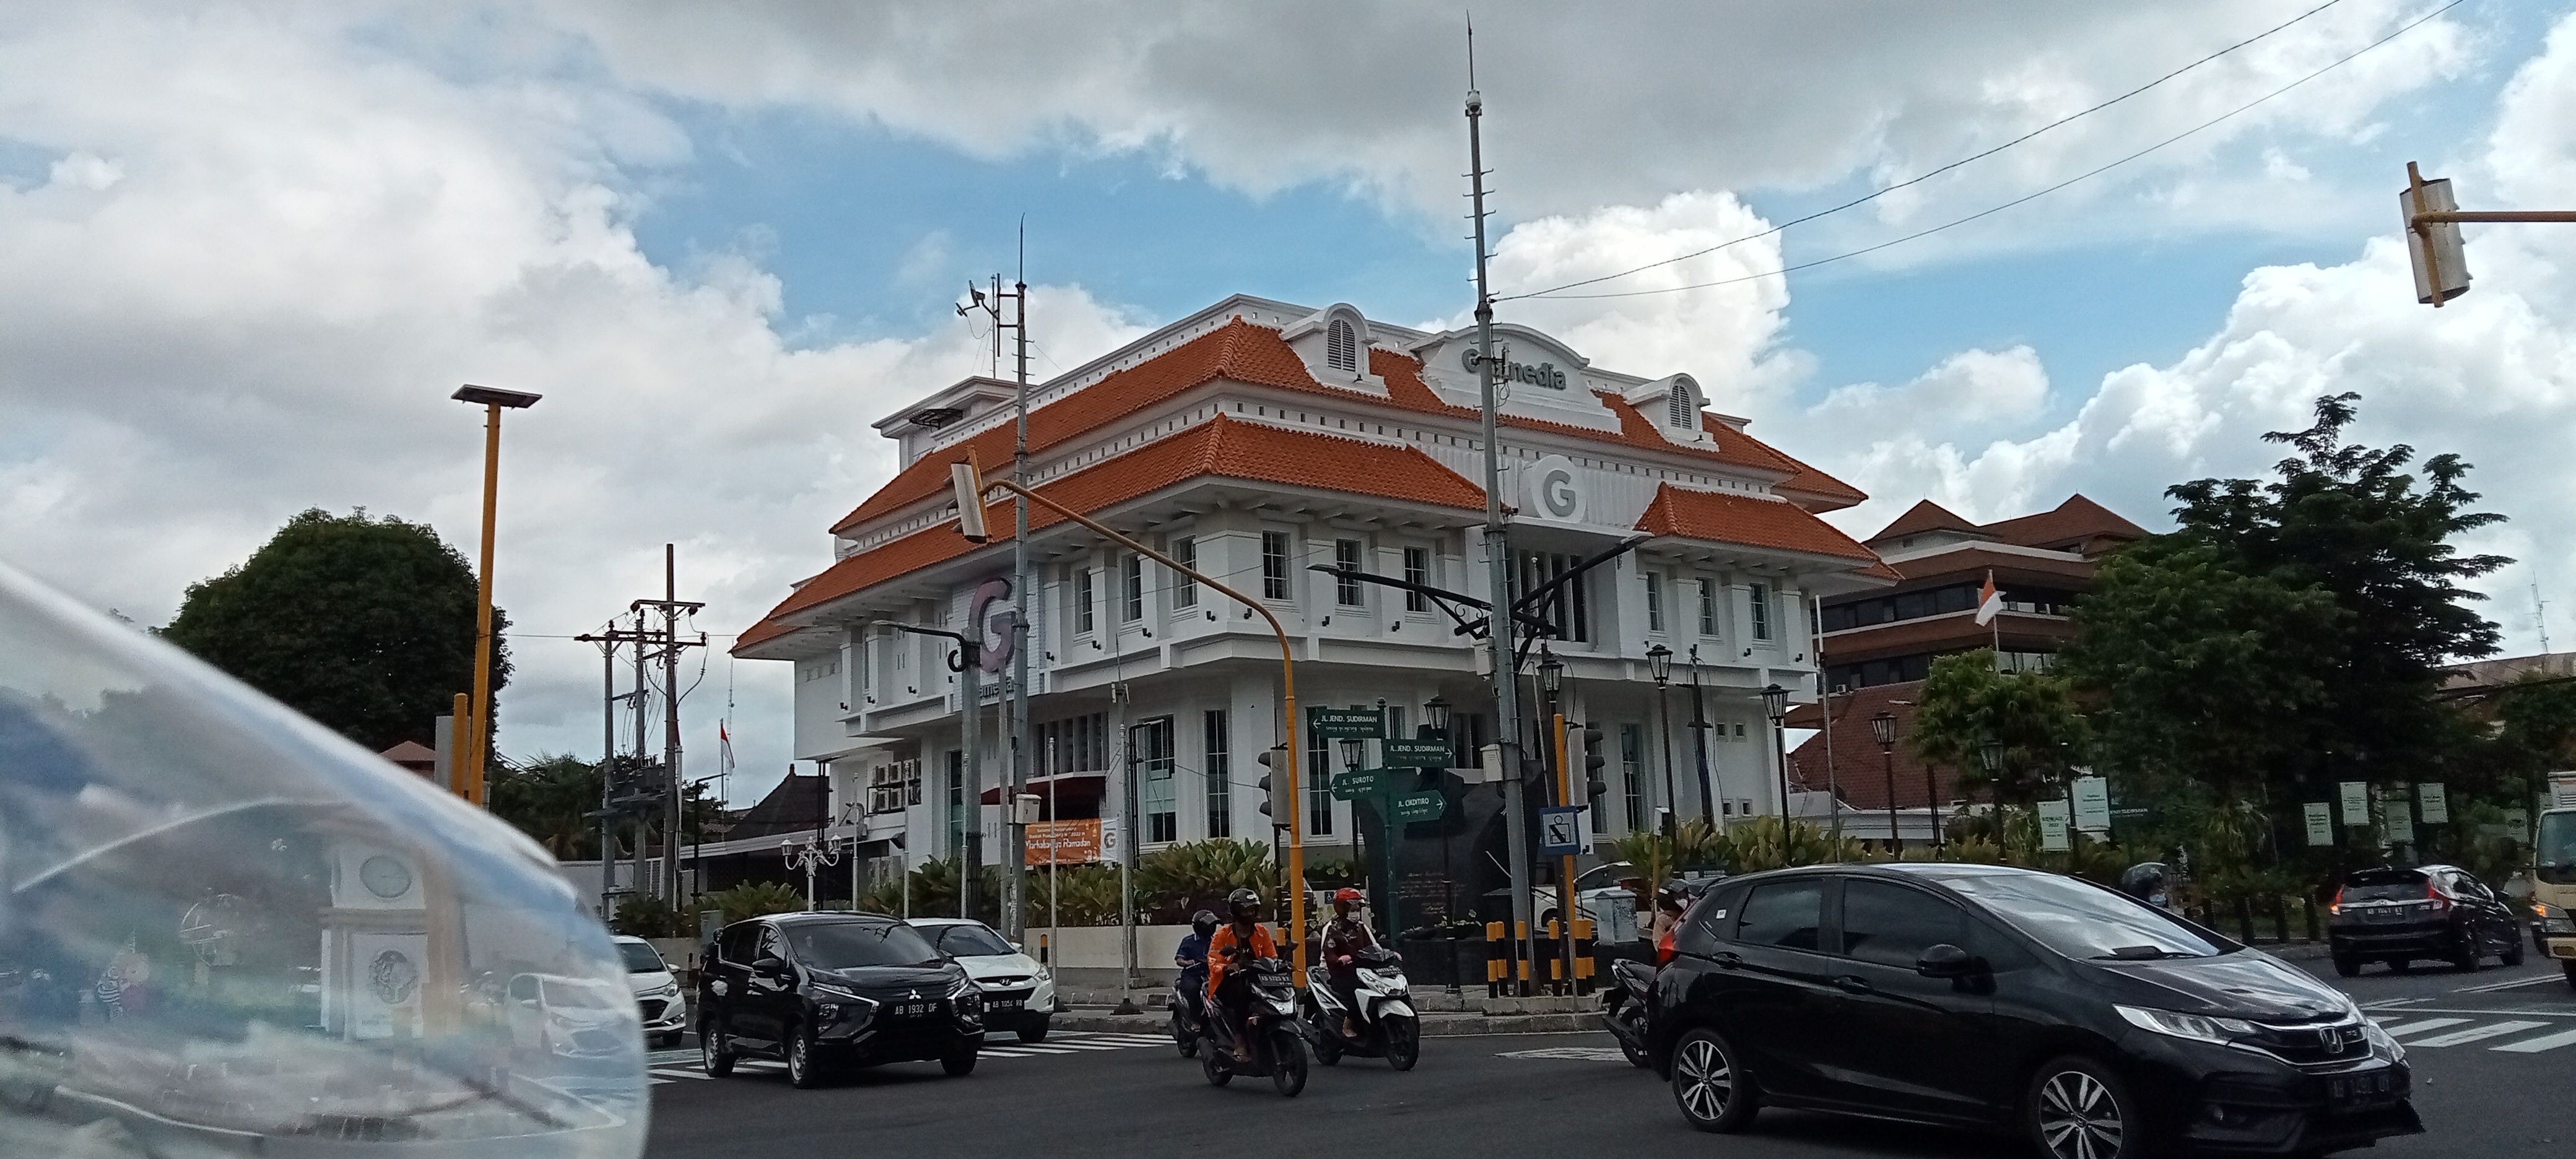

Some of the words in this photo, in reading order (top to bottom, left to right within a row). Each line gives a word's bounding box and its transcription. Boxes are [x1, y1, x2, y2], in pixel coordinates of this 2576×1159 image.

[1543, 469, 1577, 517] G
[1352, 775, 1374, 783] SUROTO
[1063, 838, 1090, 848] Ramadan
[895, 1005, 903, 1015] AB
[908, 1004, 924, 1014] 1932
[928, 1002, 937, 1012] DF
